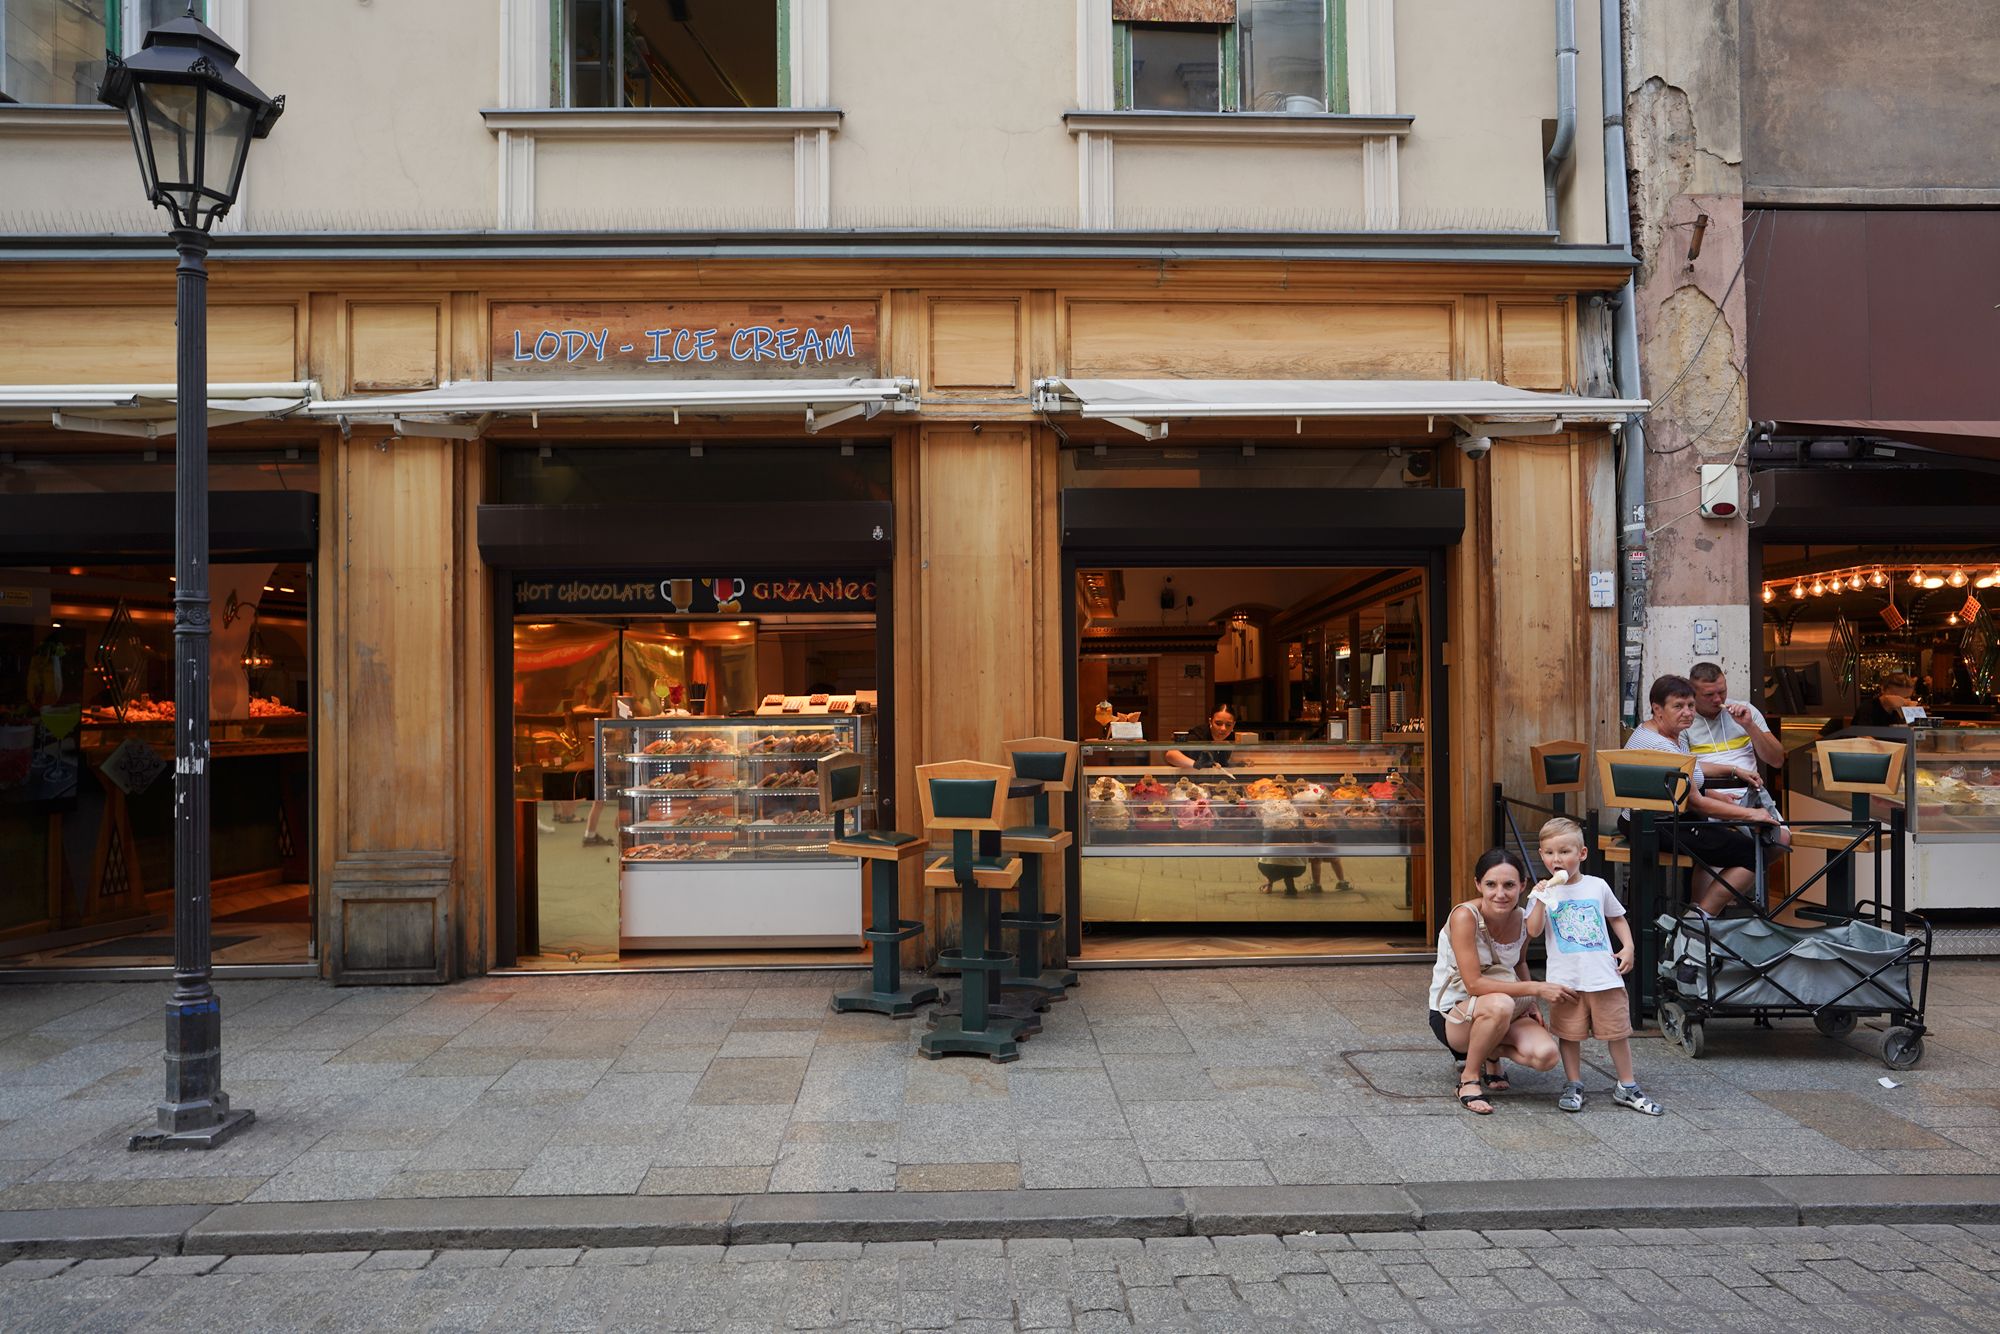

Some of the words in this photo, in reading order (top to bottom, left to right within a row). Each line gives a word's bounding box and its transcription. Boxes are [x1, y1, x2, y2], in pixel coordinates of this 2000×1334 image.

[514, 328, 608, 362] LODY
[619, 344, 634, 352] -
[645, 329, 718, 362] ICE
[729, 325, 855, 364] CREAM
[516, 581, 553, 603] HOT
[557, 580, 656, 602] CHOCOLATE
